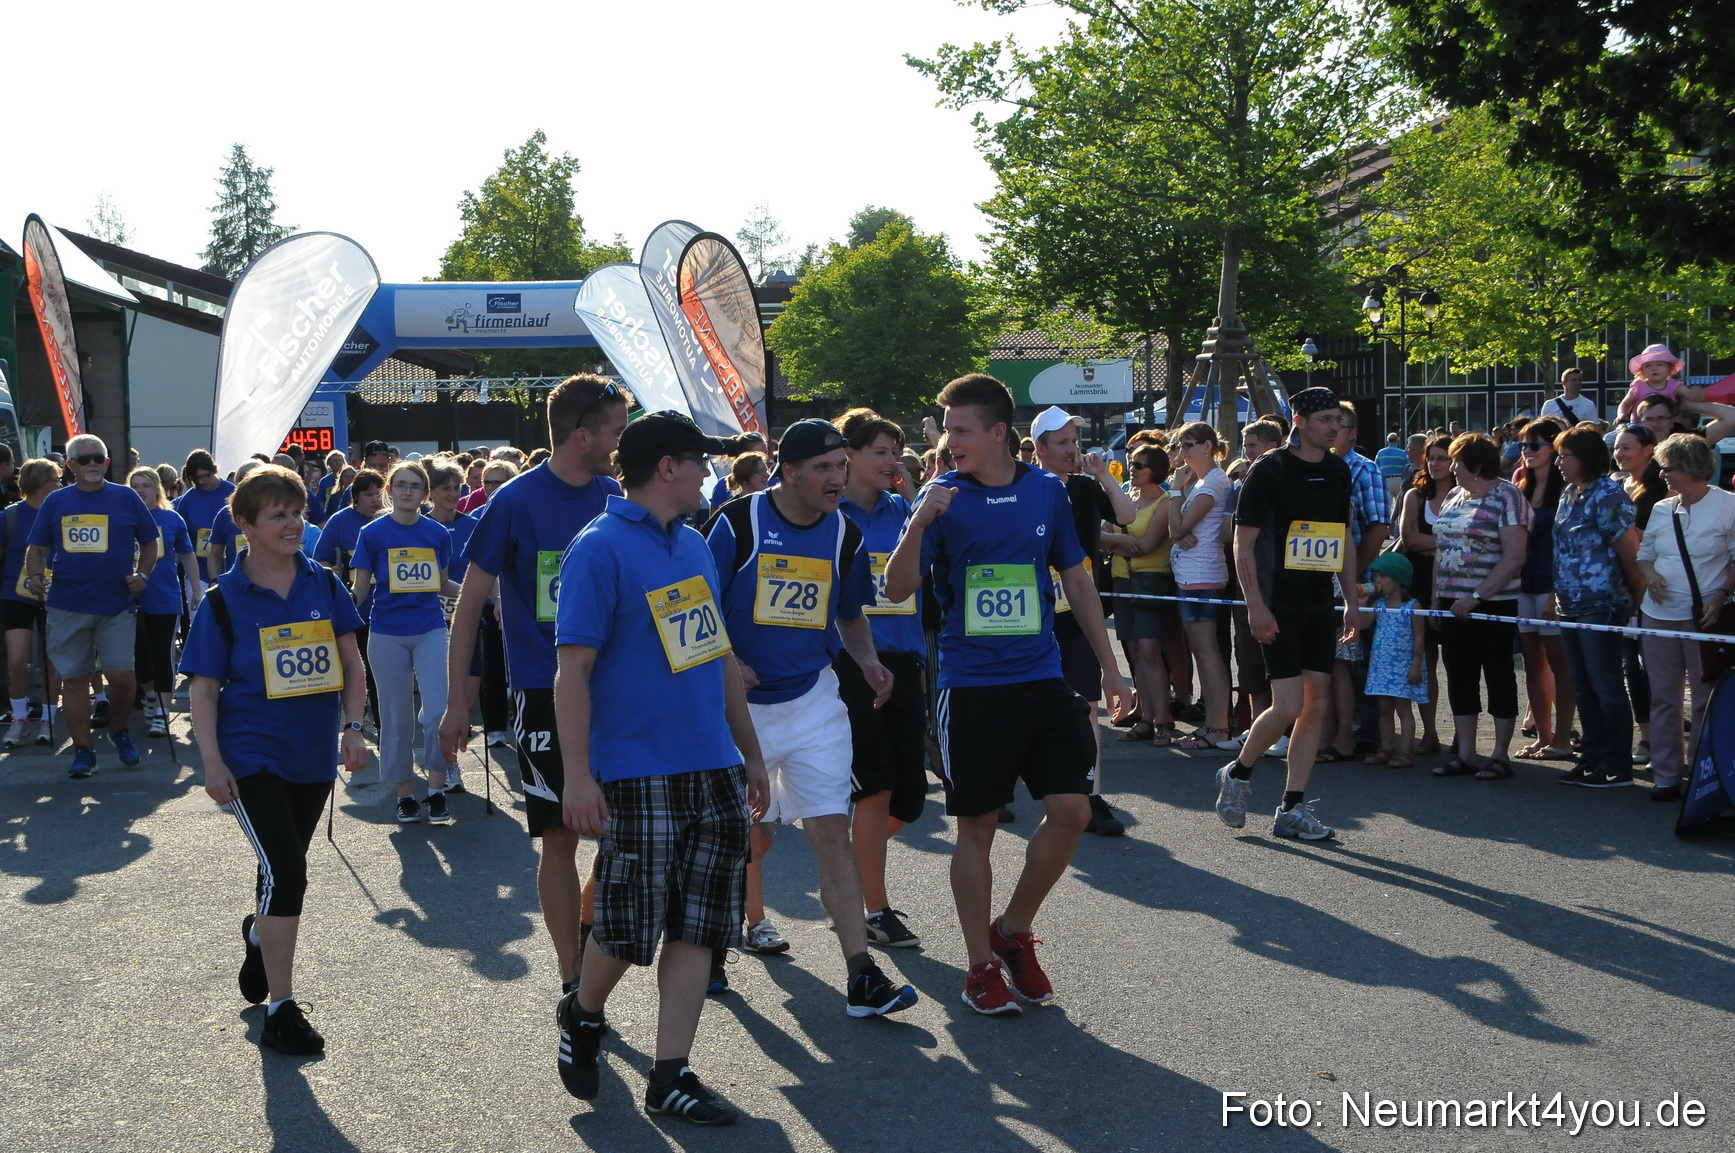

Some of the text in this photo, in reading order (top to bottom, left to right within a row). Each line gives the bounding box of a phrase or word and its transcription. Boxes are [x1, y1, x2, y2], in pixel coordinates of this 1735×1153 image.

[258, 260, 344, 384] Fischer
[475, 313, 551, 328] firmenlauf
[290, 285, 355, 382] AUTOMOBILE
[343, 341, 370, 350] cher
[1069, 388, 1108, 396] Lammsbräu
[986, 494, 1018, 505] hummel
[68, 527, 100, 543] 660
[763, 538, 783, 546] erima
[1288, 537, 1339, 559] 1101
[396, 562, 432, 581] 640
[768, 579, 819, 611] 728
[976, 588, 1026, 618] 681
[669, 604, 718, 648] 720
[276, 645, 331, 679] 688
[528, 731, 551, 753] 12
